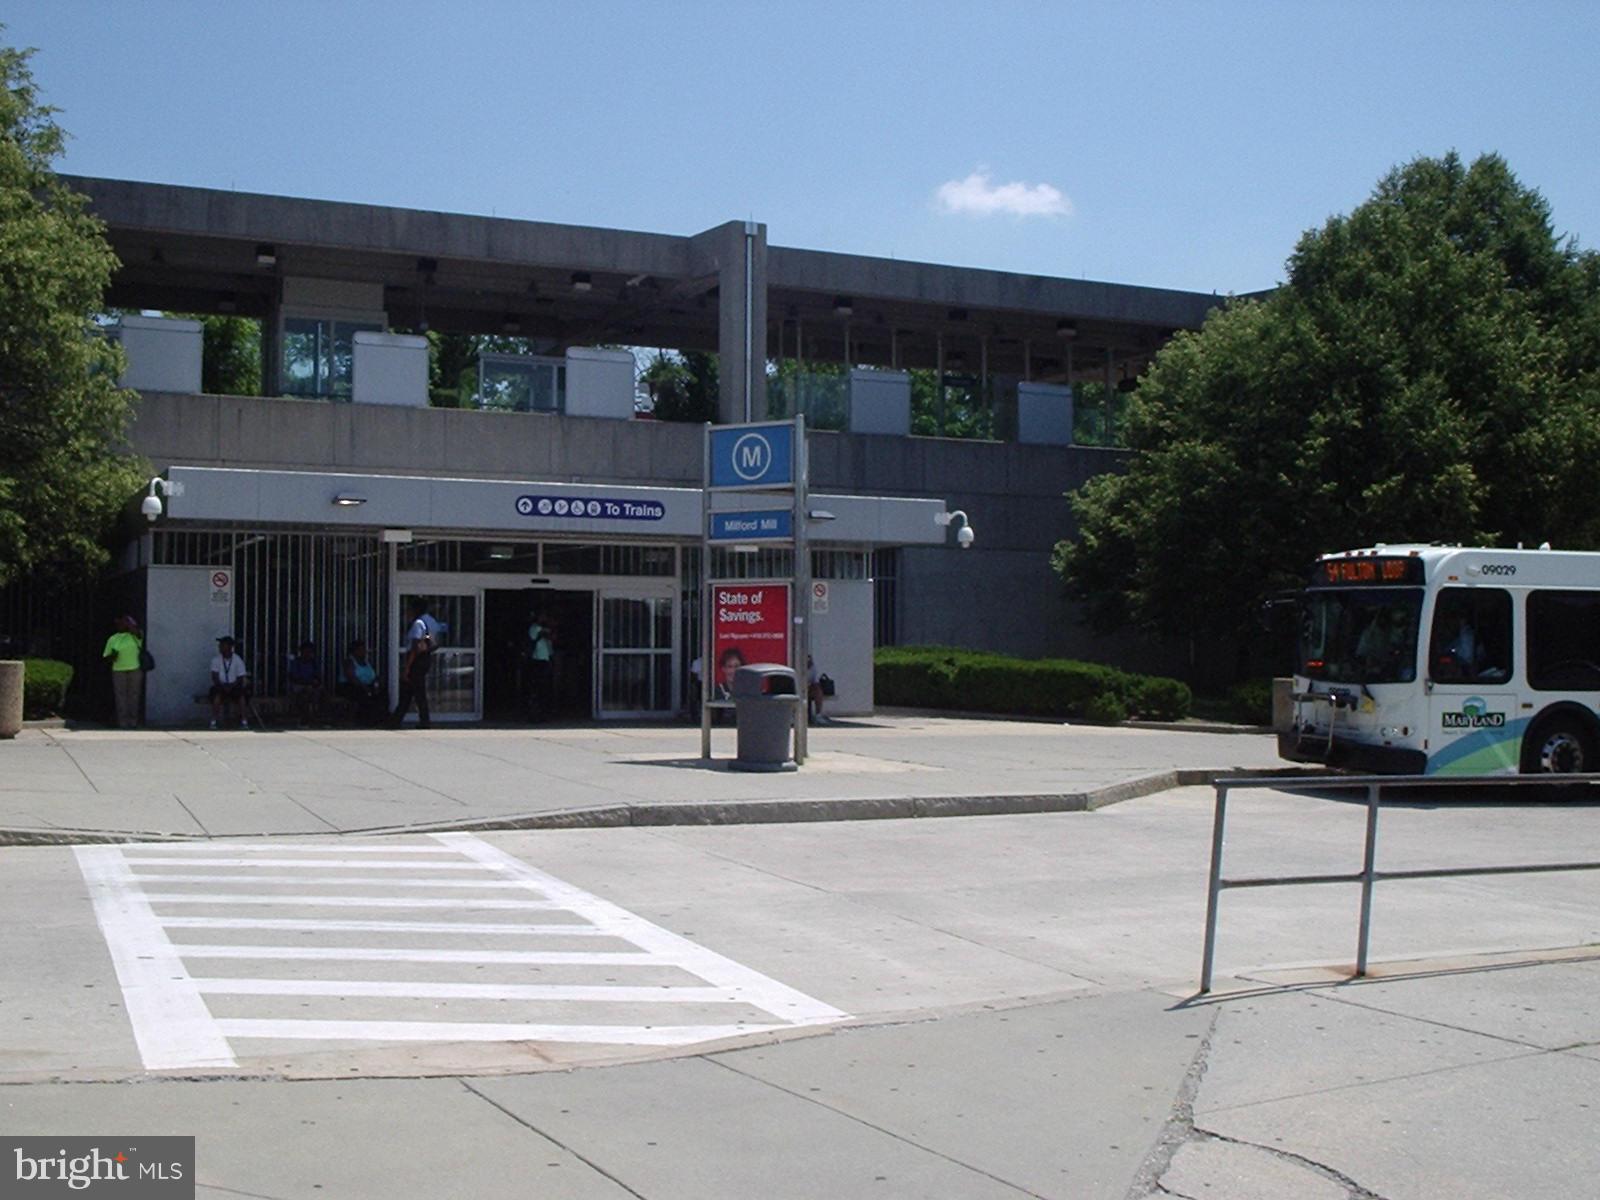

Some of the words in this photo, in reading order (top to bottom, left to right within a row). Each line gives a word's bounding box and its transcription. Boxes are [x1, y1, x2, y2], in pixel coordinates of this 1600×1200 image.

[742, 446, 761, 468] M
[605, 502, 620, 515] To
[623, 503, 662, 517] Trains
[724, 520, 758, 531] Milford
[760, 519, 778, 530] Mill
[1482, 564, 1517, 576] 09029
[719, 591, 749, 604] State
[751, 591, 763, 605] of
[719, 608, 765, 624] Savings.
